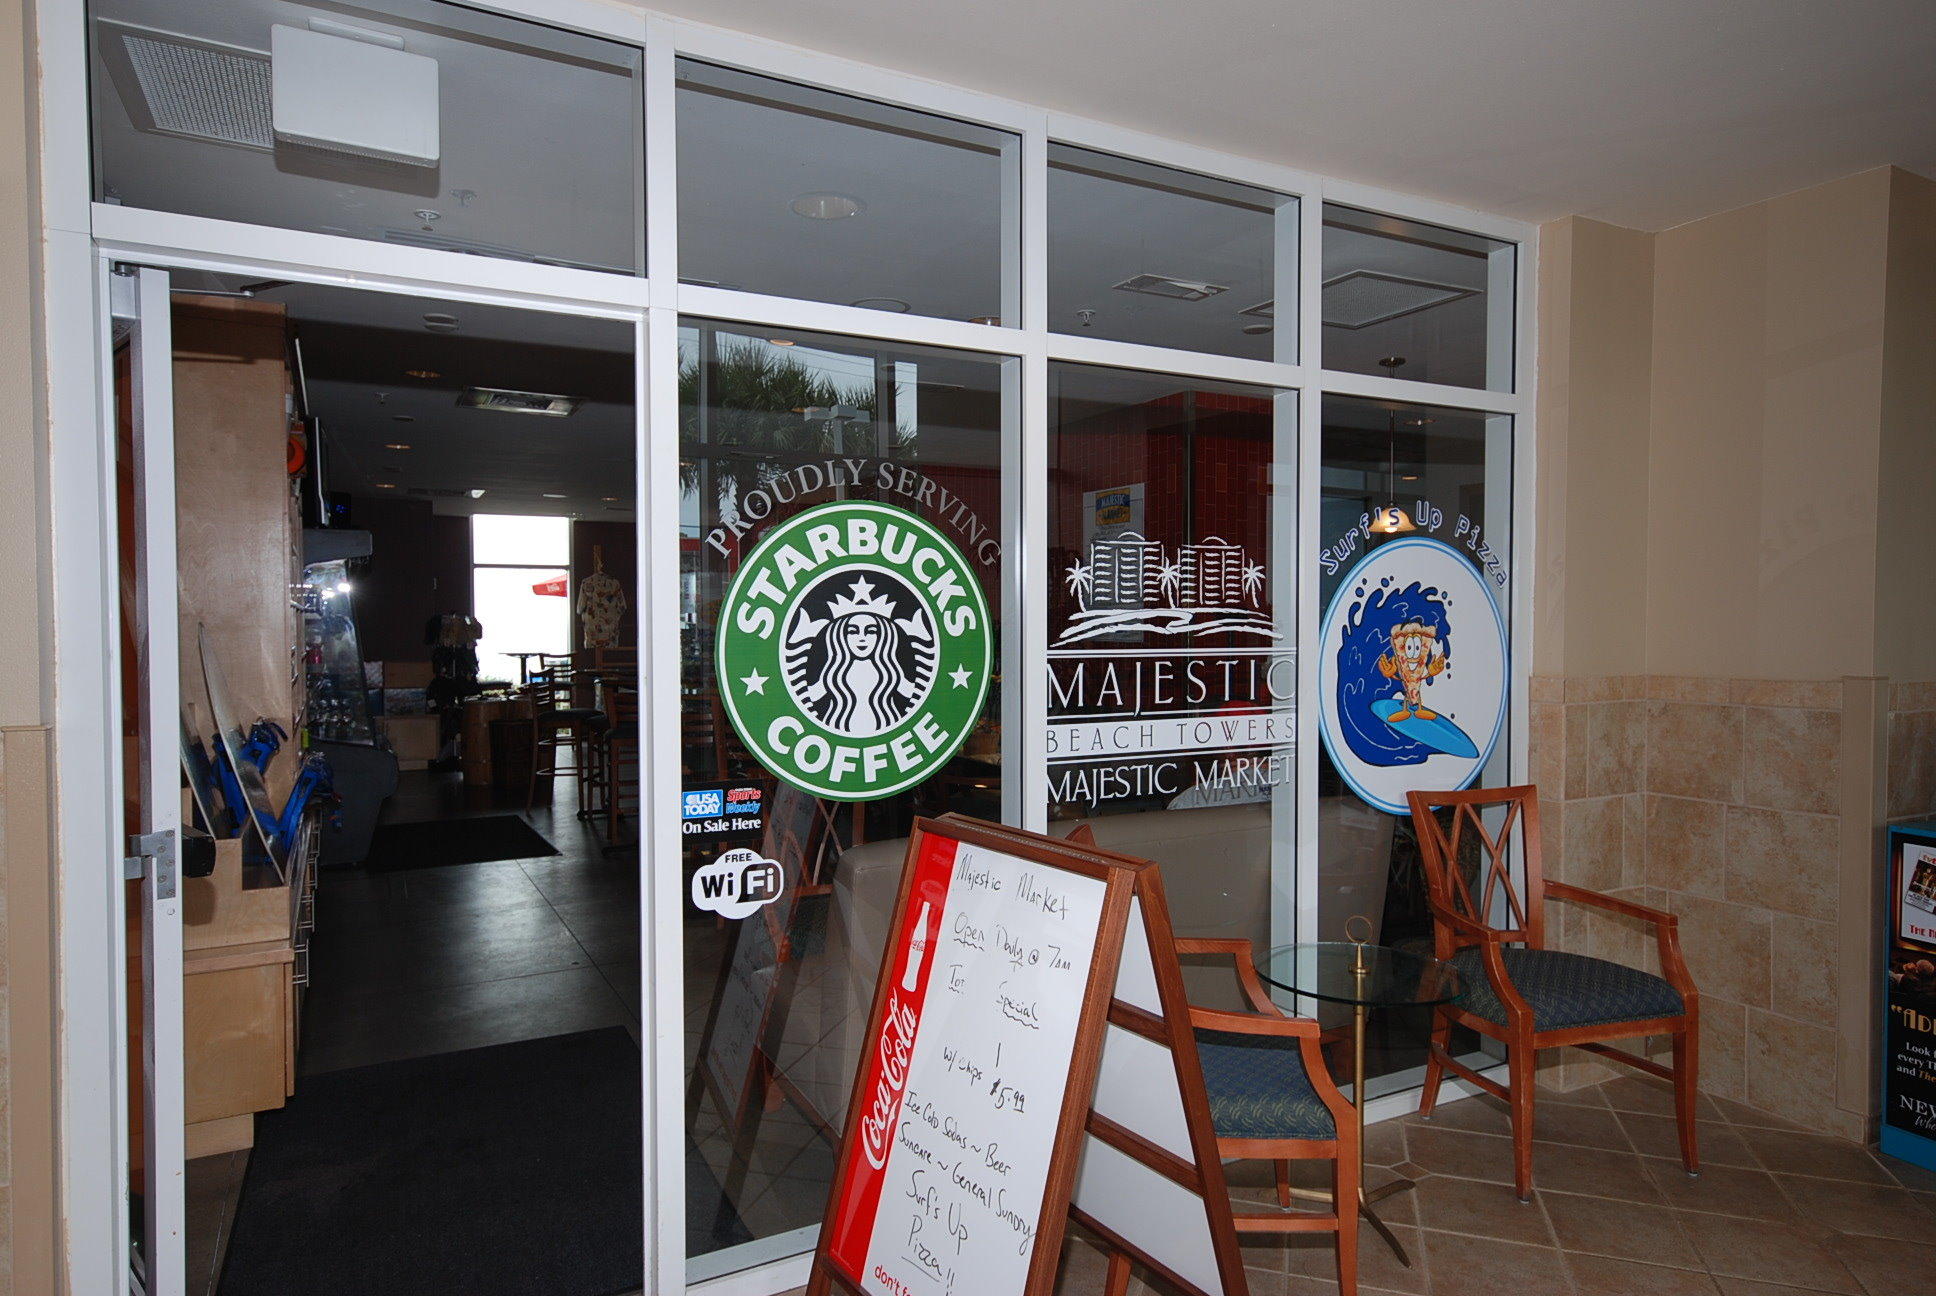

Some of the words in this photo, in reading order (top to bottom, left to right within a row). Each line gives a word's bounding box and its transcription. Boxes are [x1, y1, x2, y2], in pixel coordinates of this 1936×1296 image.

[704, 458, 867, 559] PROUDLY
[877, 461, 1001, 567] SERVING
[1320, 507, 1400, 575] Surf's
[1416, 500, 1443, 532] Up
[1455, 514, 1509, 589] Pizza
[737, 519, 976, 640] STARBUCKS
[1047, 659, 1295, 716] MAJESTIC
[767, 712, 950, 783] COFFEE
[1047, 724, 1153, 753] BEACH
[1176, 717, 1294, 746] TOWERS
[697, 793, 720, 804] USA
[727, 788, 761, 803] Sports
[1046, 763, 1178, 809] MAJESTIC
[1194, 755, 1295, 791] MARKET
[683, 821, 702, 834] On
[704, 819, 729, 833] Sale
[732, 817, 761, 831] Here
[684, 803, 721, 816] TODAY
[725, 852, 752, 863] FREE
[957, 853, 1001, 891] Majestic
[1015, 872, 1069, 921] Market
[955, 911, 985, 948] Open
[1028, 948, 1040, 966] @
[1896, 1065, 1916, 1077] and
[1897, 1053, 1924, 1069] every
[1906, 1042, 1931, 1057] Look
[904, 1090, 920, 1115] Ice
[985, 1142, 1012, 1176] Beer
[899, 1121, 932, 1165] Suncare
[952, 1161, 992, 1209] General
[905, 1169, 941, 1220] Surf's
[948, 1202, 968, 1256] Up
[874, 1264, 900, 1296] don't
